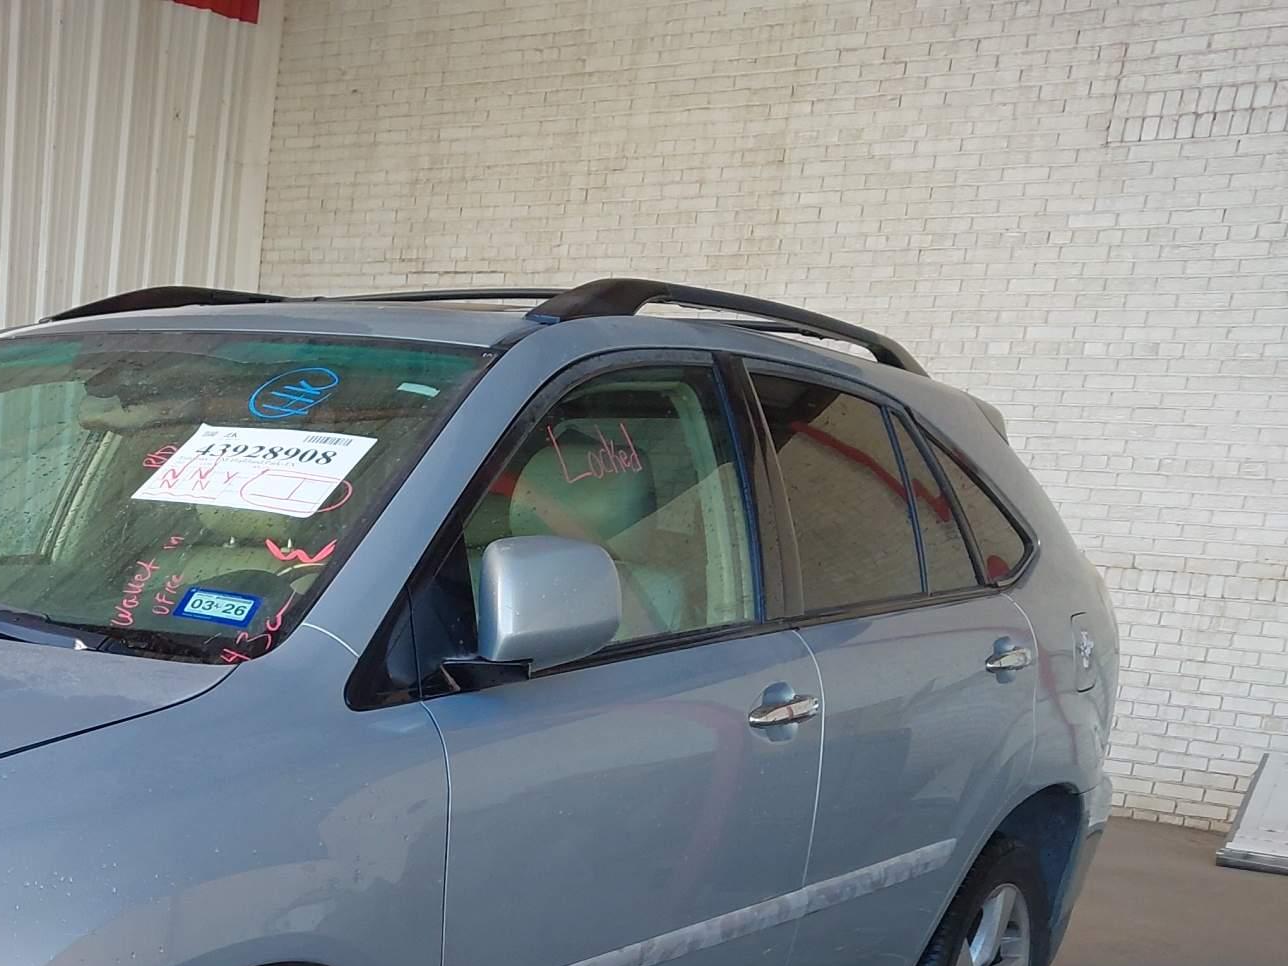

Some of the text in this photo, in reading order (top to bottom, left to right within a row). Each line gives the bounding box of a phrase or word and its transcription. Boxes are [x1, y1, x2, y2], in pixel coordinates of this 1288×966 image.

[196, 443, 337, 466] 43928908
[191, 598, 215, 611] 03
[221, 603, 247, 616] 26
